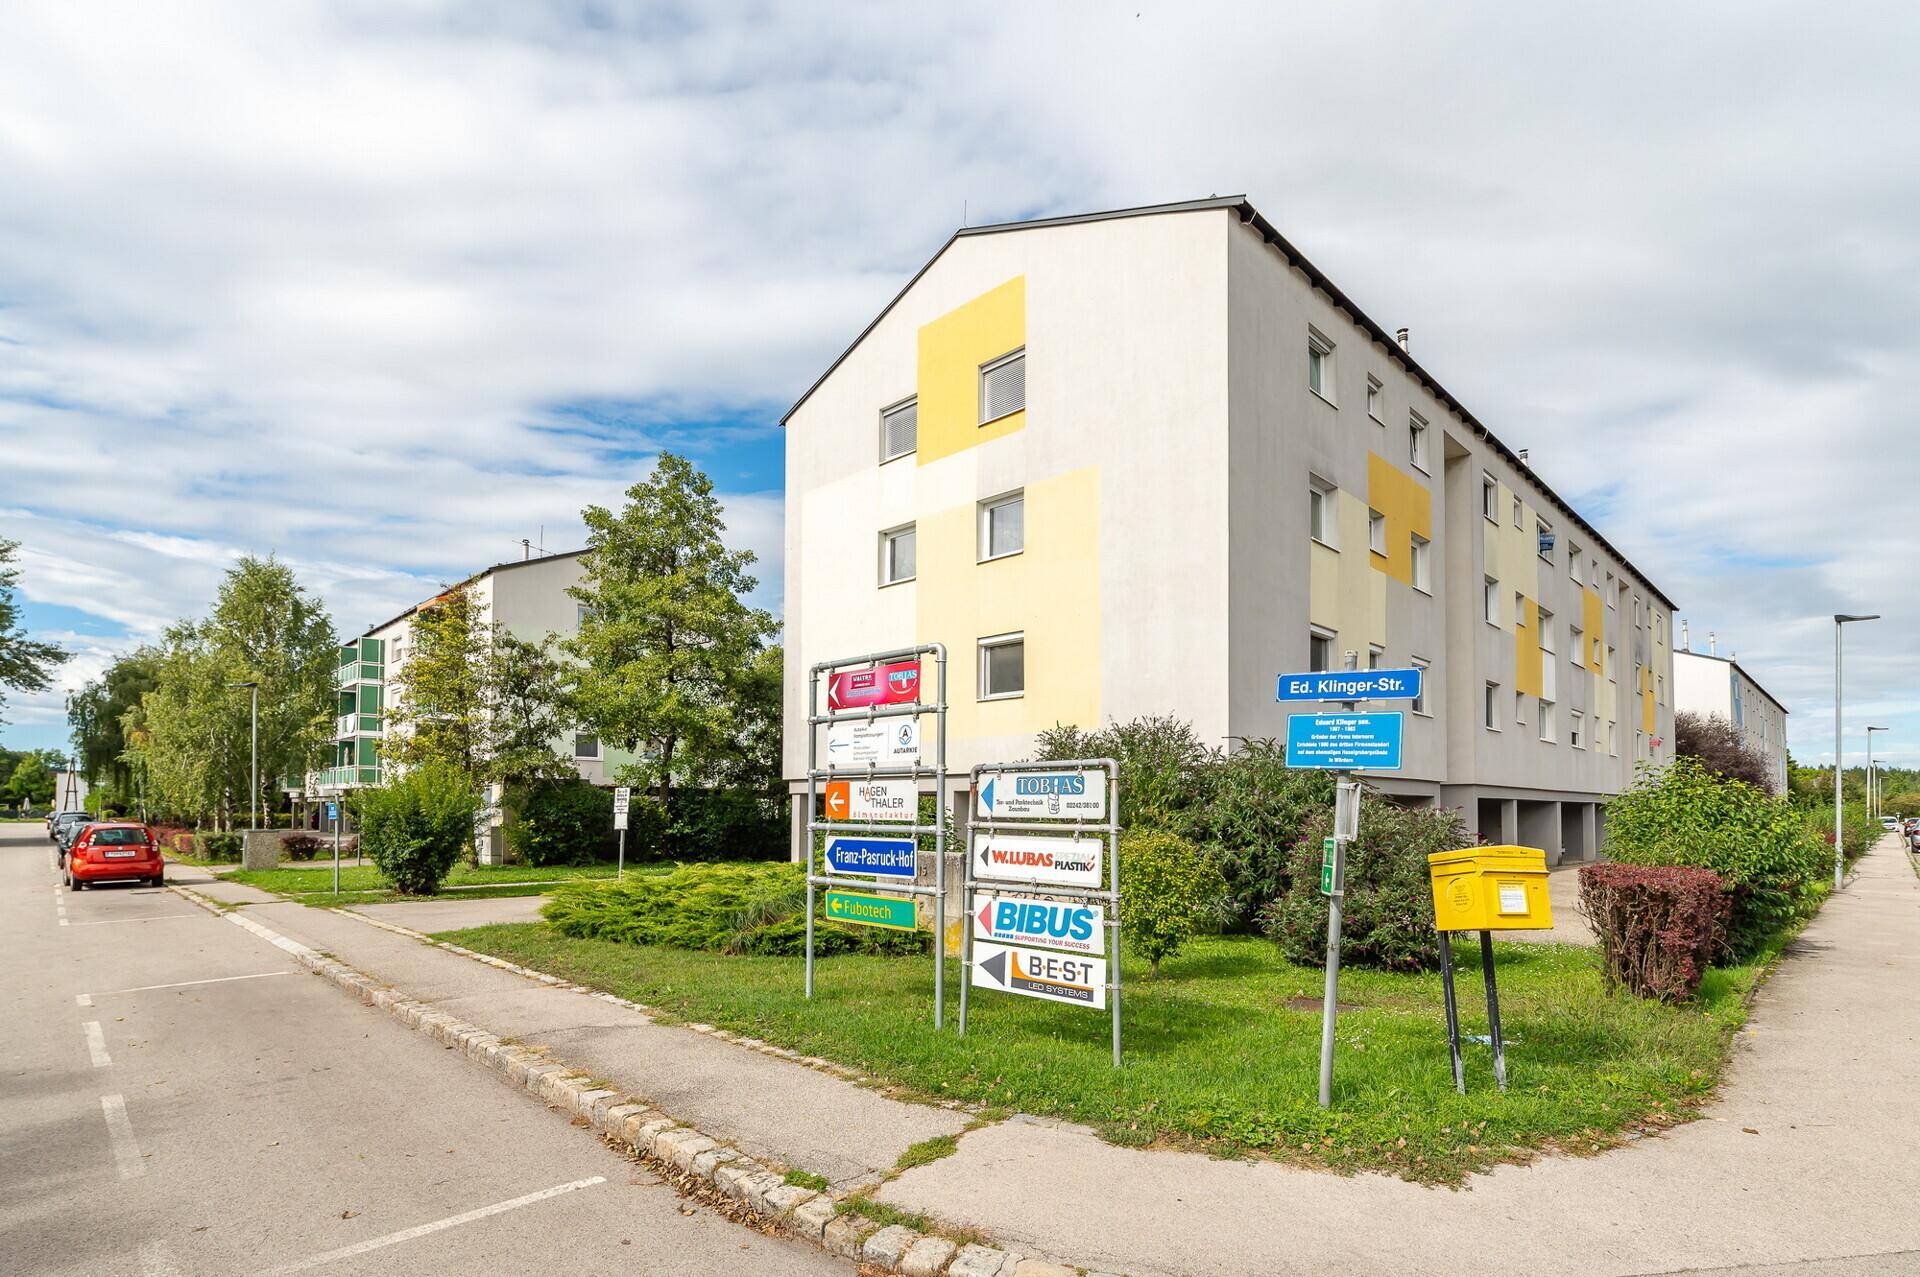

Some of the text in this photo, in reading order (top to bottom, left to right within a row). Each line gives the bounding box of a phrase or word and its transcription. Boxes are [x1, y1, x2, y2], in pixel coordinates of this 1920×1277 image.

[1290, 677, 1405, 695] Ed. Klinger-Str.
[859, 786, 887, 798] HAGEN
[871, 798, 904, 808] THALER
[836, 847, 914, 867] Franz-Pasruck-Hof
[1055, 861, 1090, 872] PLASTIK
[844, 900, 892, 919] Fubotech
[995, 902, 1094, 940] BIBUS
[1015, 935, 1091, 950] SUPPORTING YOUR SUCCESS
[1029, 982, 1088, 999] LED SYSTEMS
